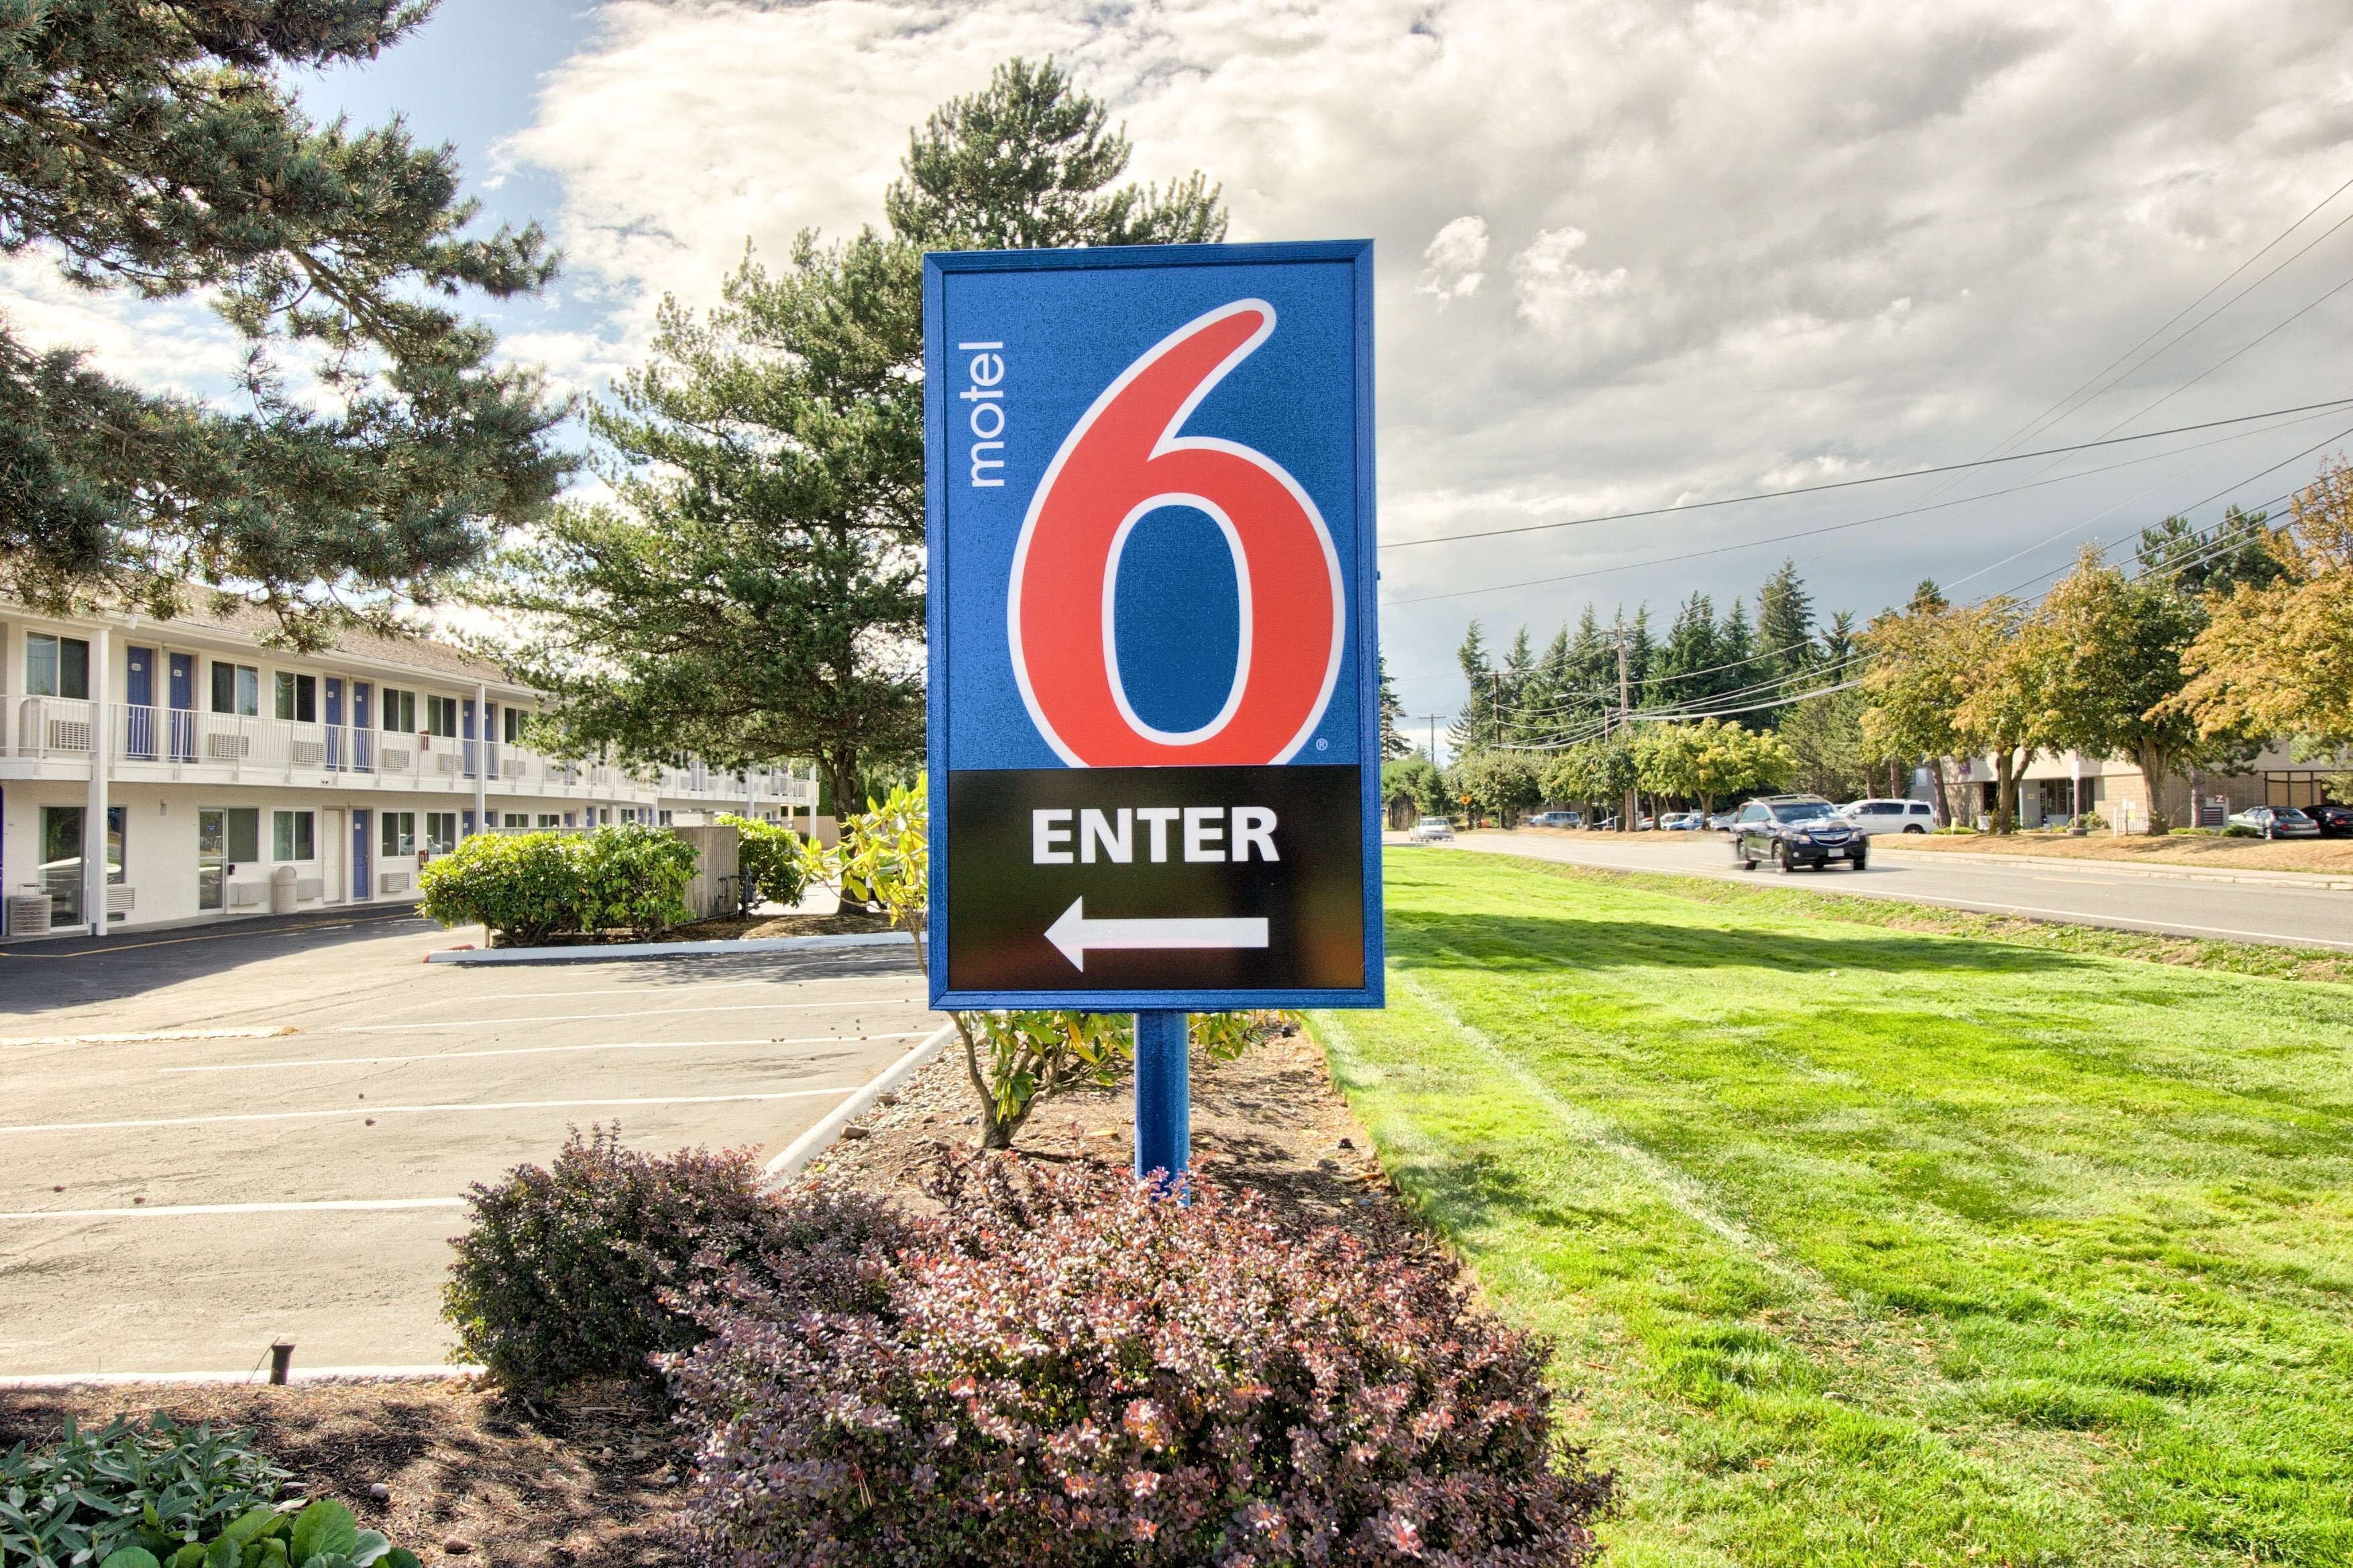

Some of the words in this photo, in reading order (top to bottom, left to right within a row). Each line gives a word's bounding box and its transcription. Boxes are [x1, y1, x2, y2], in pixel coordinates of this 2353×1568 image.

[959, 341, 1005, 488] motel
[1007, 297, 1346, 767] 6
[1032, 805, 1280, 864] ENTER
